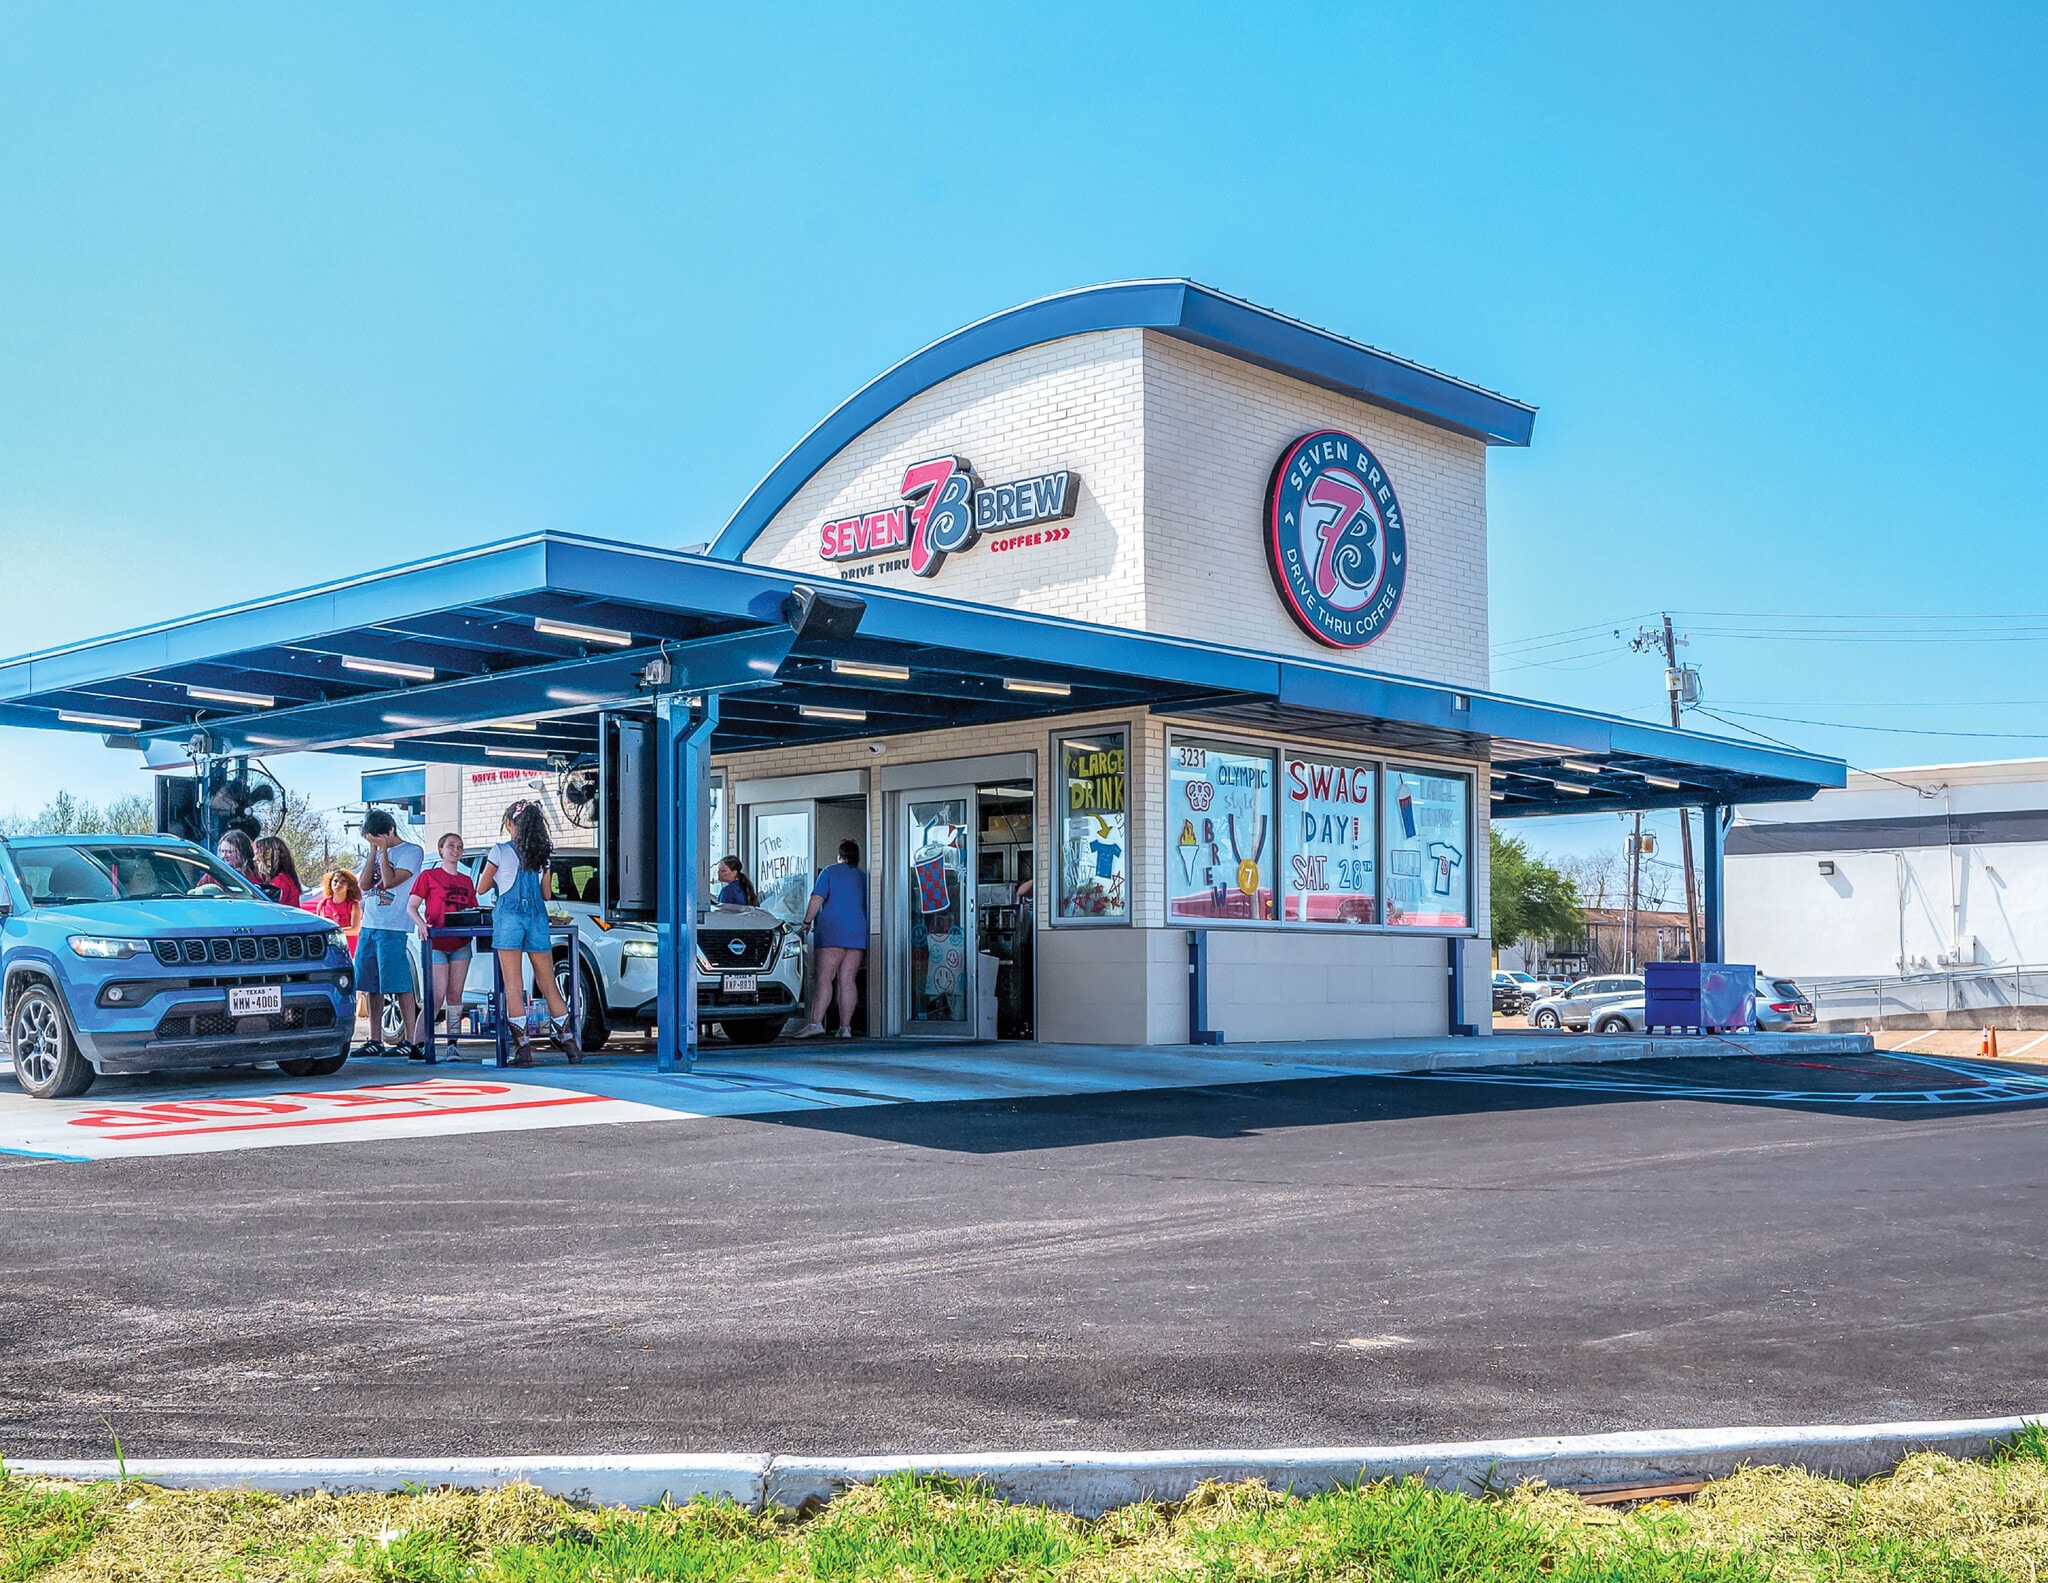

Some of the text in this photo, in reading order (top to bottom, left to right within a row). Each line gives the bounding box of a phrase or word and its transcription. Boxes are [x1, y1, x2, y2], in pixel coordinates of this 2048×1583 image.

[1290, 441, 1401, 530] SEVEN BREW
[821, 508, 906, 557] SEVEN
[976, 473, 1066, 528] BREW
[991, 532, 1042, 553] COFFEE
[841, 558, 910, 580] DRIVE THRU
[1287, 548, 1397, 635] DRIVE THRU COFFEE
[1079, 749, 1124, 777] LARGE
[1180, 747, 1207, 769] 3231
[472, 772, 496, 783] DRIVE
[498, 769, 520, 780] THRU
[1218, 765, 1269, 789] OLYMPIC
[1289, 760, 1368, 804] SWAG
[1072, 775, 1124, 809] DRINK
[760, 836, 782, 855] The
[1292, 854, 1330, 891] SAT.
